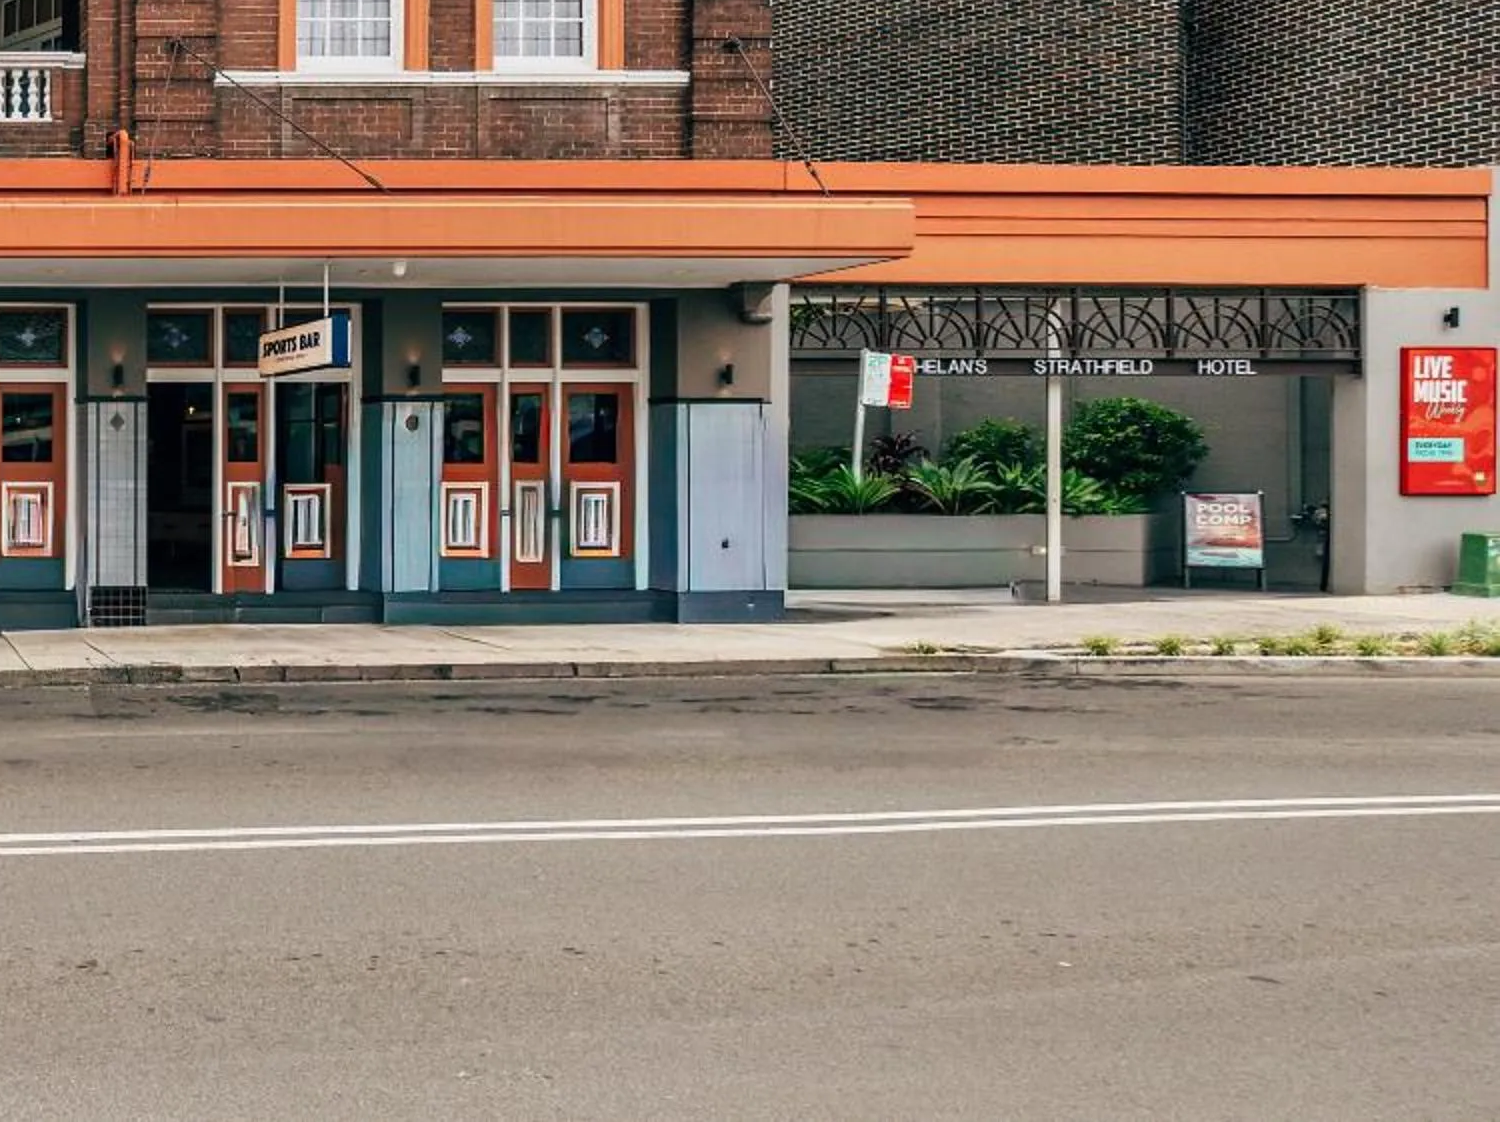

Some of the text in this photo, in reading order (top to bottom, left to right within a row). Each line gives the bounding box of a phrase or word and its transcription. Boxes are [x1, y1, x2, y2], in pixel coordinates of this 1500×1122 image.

[263, 335, 297, 358] SPORTS
[300, 331, 321, 350] BAR
[1033, 360, 1153, 375] STRATHFIELD
[1198, 360, 1258, 375] HOTEL
[1414, 355, 1452, 379] LIVE
[1414, 379, 1467, 403] MUSIC
[1197, 503, 1250, 514] POOL
[1196, 515, 1253, 526] COMP
